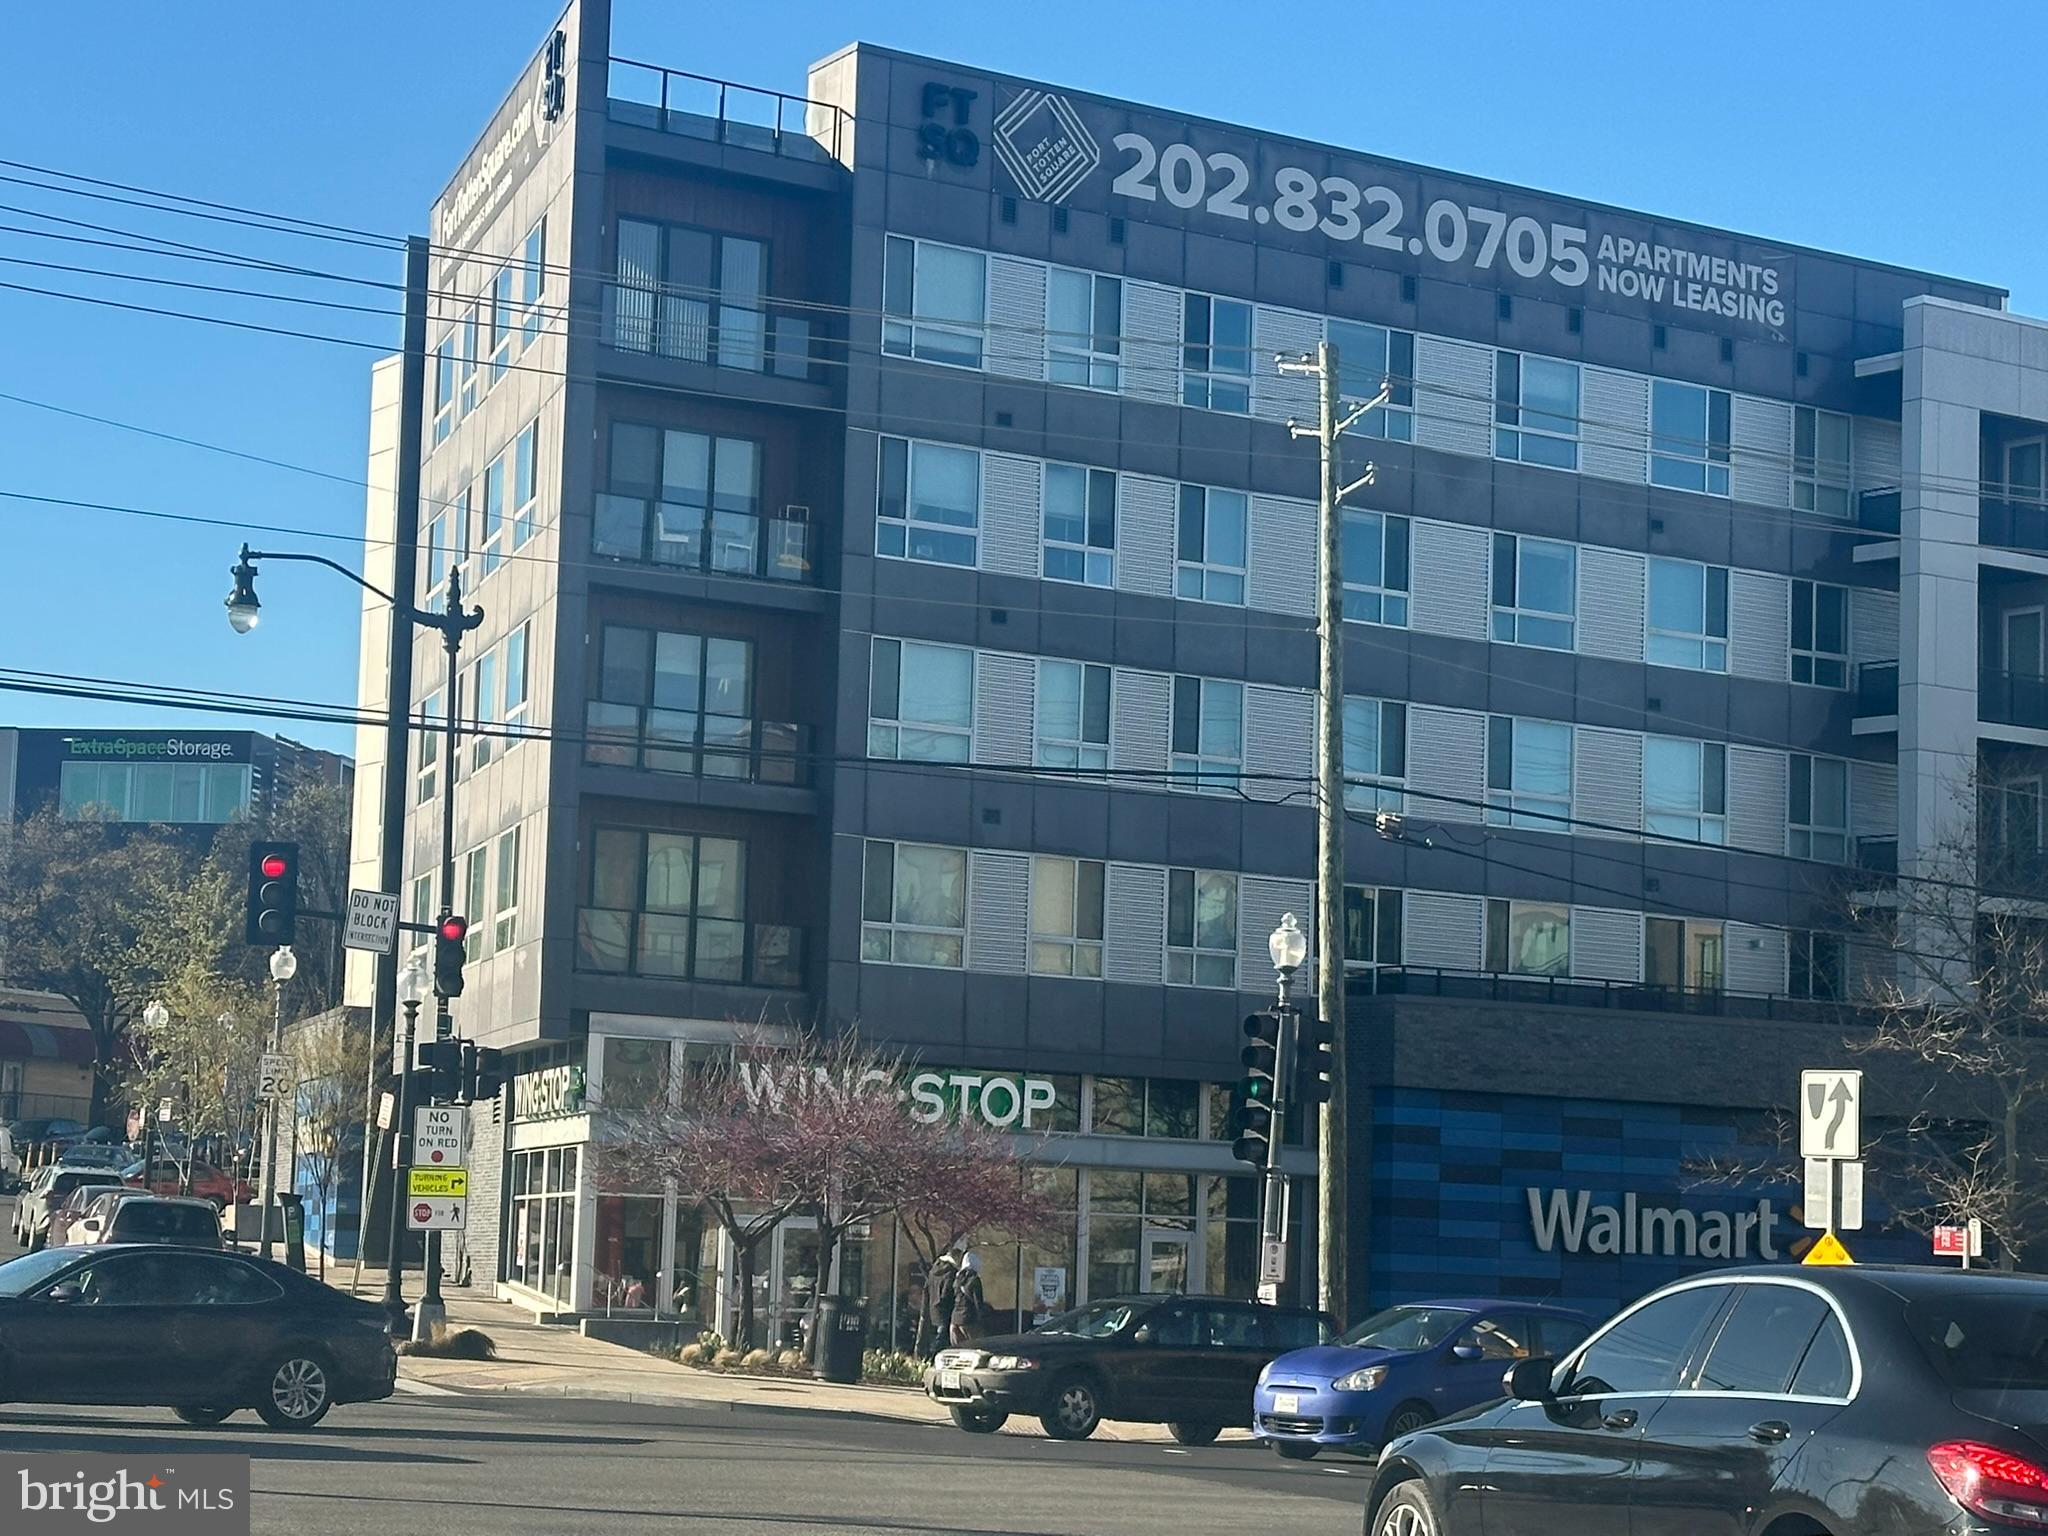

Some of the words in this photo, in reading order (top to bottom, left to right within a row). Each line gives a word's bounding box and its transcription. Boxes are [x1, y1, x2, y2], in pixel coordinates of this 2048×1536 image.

[922, 81, 978, 125] FT
[1026, 136, 1052, 164] FORT
[1033, 136, 1069, 174] TOTTEN
[1040, 144, 1077, 184] SQUARE
[1112, 132, 1590, 287] 202.832.0705
[1596, 233, 1779, 296] APARTMENTS
[1598, 264, 1666, 303] NOW
[1673, 279, 1786, 327] LEASING
[353, 894, 369, 909] DO
[373, 898, 396, 913] NOT
[353, 913, 389, 930] BLOCK
[429, 1111, 450, 1123] NO
[425, 1125, 453, 1136] TURN
[418, 1138, 433, 1148] ON
[437, 1138, 458, 1148] RED
[413, 1184, 449, 1193] VEHICLES
[414, 1173, 448, 1182] TURNING
[414, 1208, 432, 1218] STOP
[1526, 1187, 1780, 1261] Walmart
